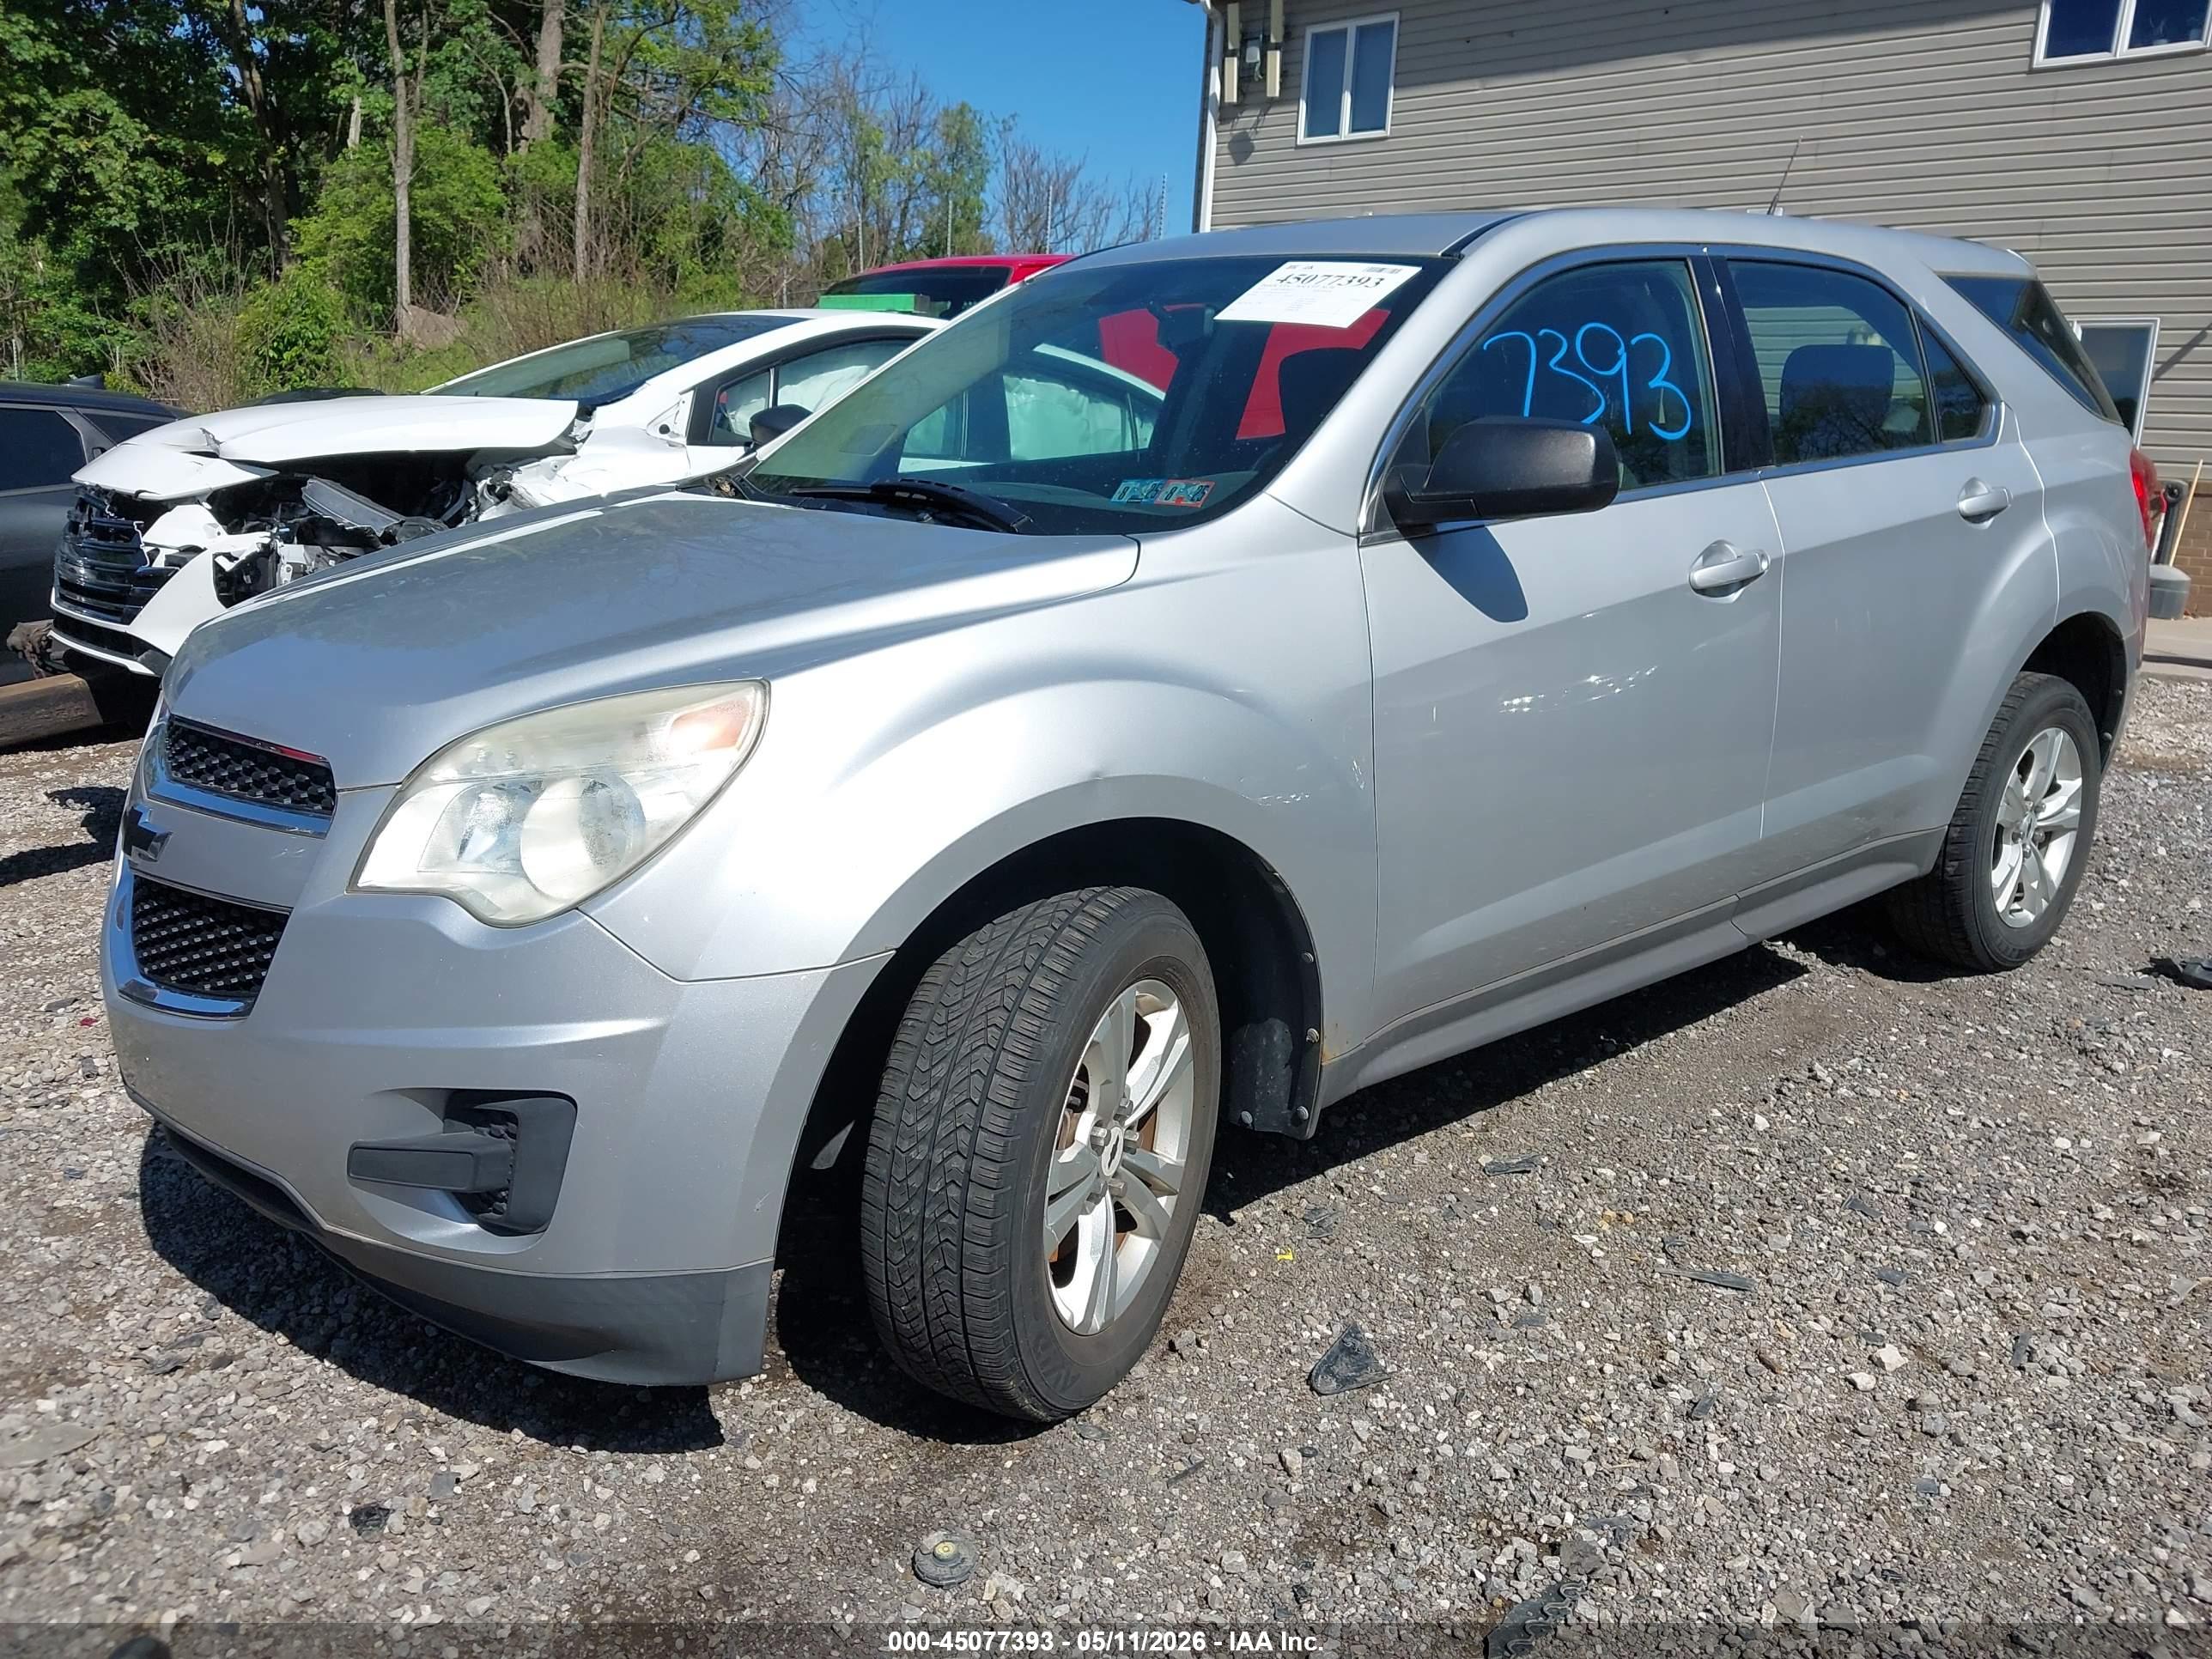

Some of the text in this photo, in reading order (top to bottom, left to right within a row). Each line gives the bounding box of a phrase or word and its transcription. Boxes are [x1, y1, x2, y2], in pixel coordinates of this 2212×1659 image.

[1276, 273, 1385, 289] 45077393
[1483, 322, 1692, 441] 7393
[1118, 486, 1131, 500] 8
[1164, 484, 1210, 502] 8 25
